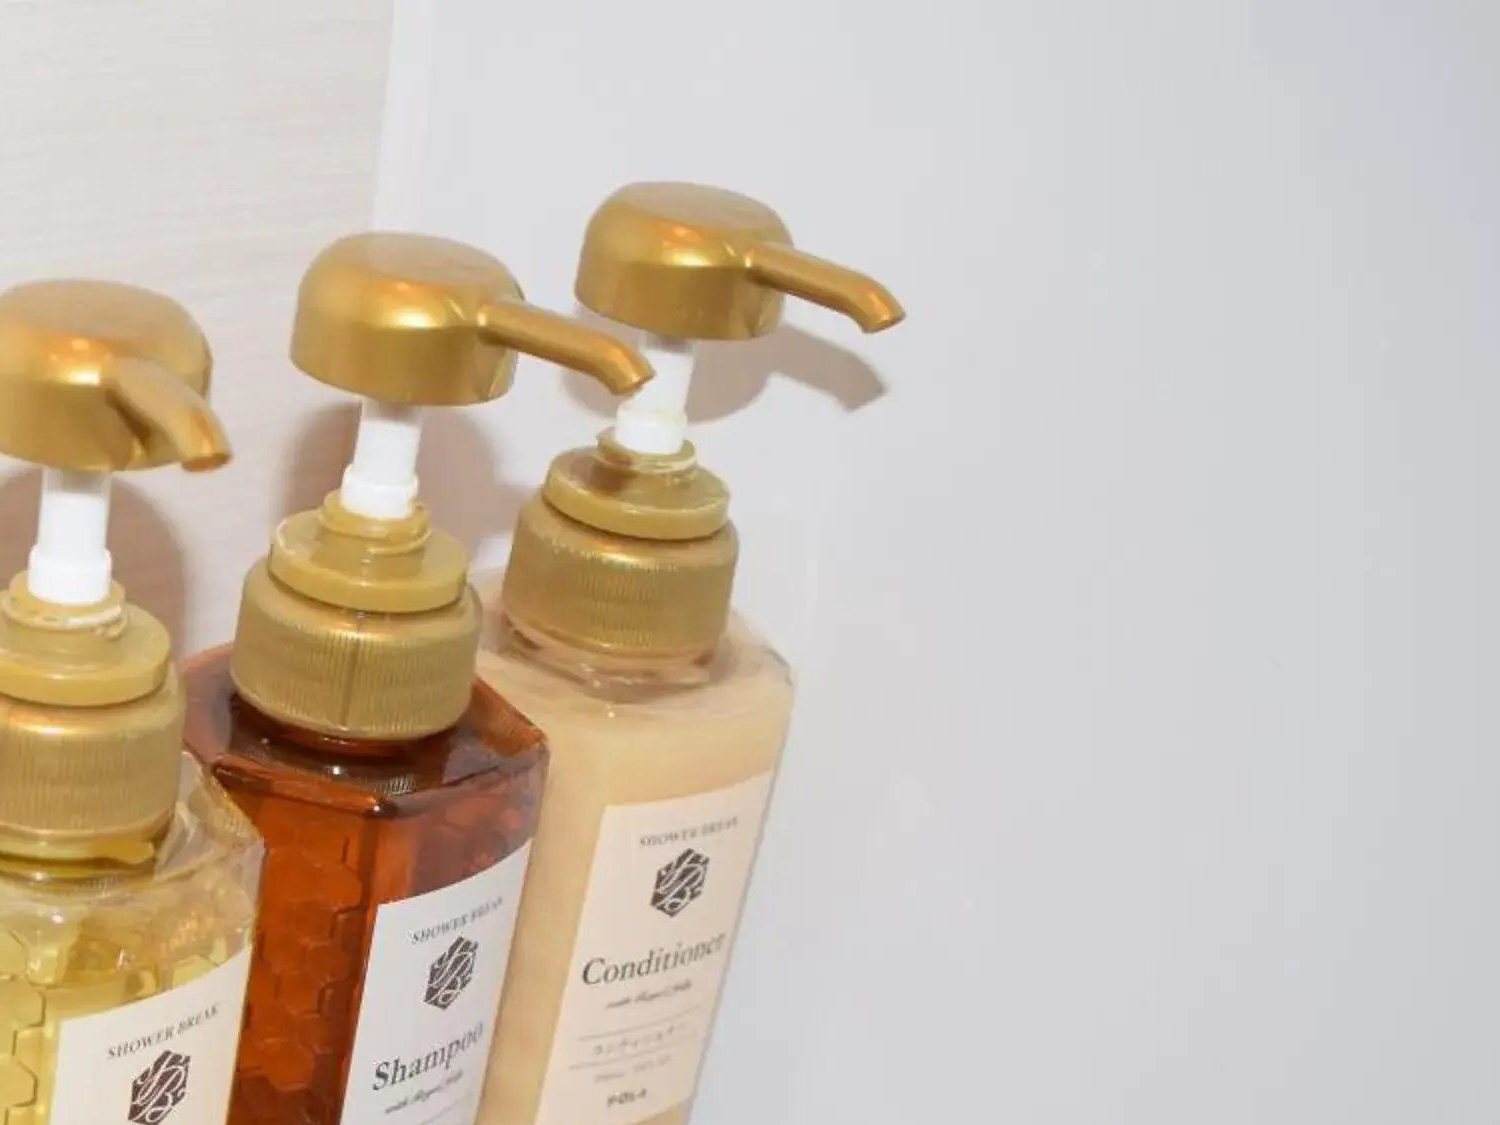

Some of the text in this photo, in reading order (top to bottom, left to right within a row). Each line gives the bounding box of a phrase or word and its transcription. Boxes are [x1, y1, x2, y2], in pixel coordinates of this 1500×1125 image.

[581, 932, 726, 985] Conditioner
[107, 1027, 174, 1060] SHOWER
[372, 1020, 484, 1091] Shampoo
